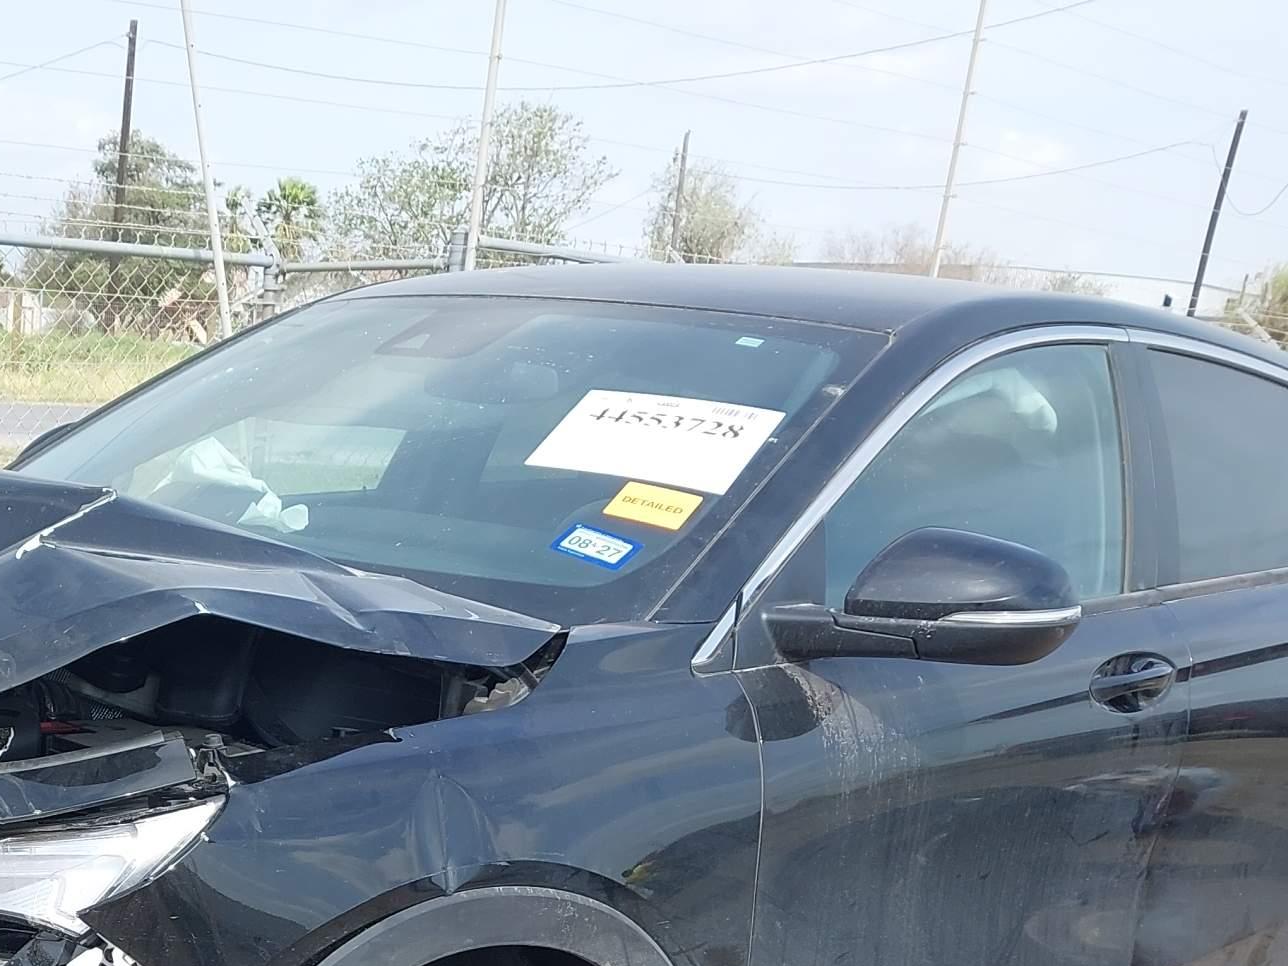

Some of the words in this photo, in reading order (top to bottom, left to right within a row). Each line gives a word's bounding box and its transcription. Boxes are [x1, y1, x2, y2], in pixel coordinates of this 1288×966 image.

[589, 407, 744, 439] 44553728
[621, 495, 684, 514] DETAILED
[568, 535, 593, 549] 08
[595, 544, 624, 558] 27
